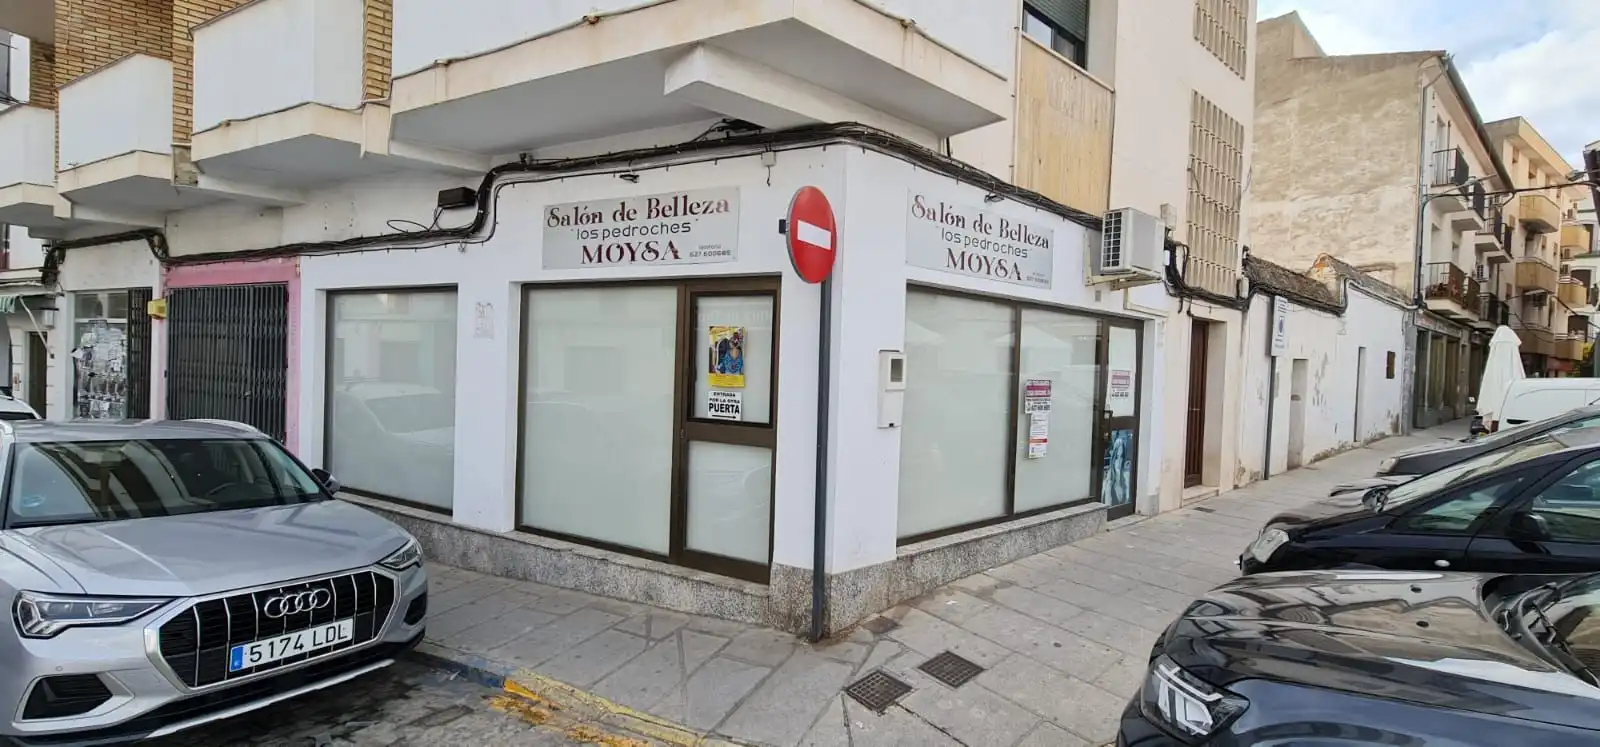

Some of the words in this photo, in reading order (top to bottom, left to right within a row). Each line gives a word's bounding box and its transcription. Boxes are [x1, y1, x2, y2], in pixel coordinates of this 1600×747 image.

[547, 205, 603, 228] Salón
[612, 201, 637, 222] de
[647, 194, 730, 220] Belleza
[912, 194, 966, 229] Salón
[972, 213, 992, 235] de
[999, 217, 1049, 249] Belleza
[581, 239, 682, 265] MOYSA
[945, 247, 1022, 281] MOYSA
[709, 402, 740, 414] PUERTA
[249, 634, 305, 663] 5174
[312, 624, 348, 647] LDL
